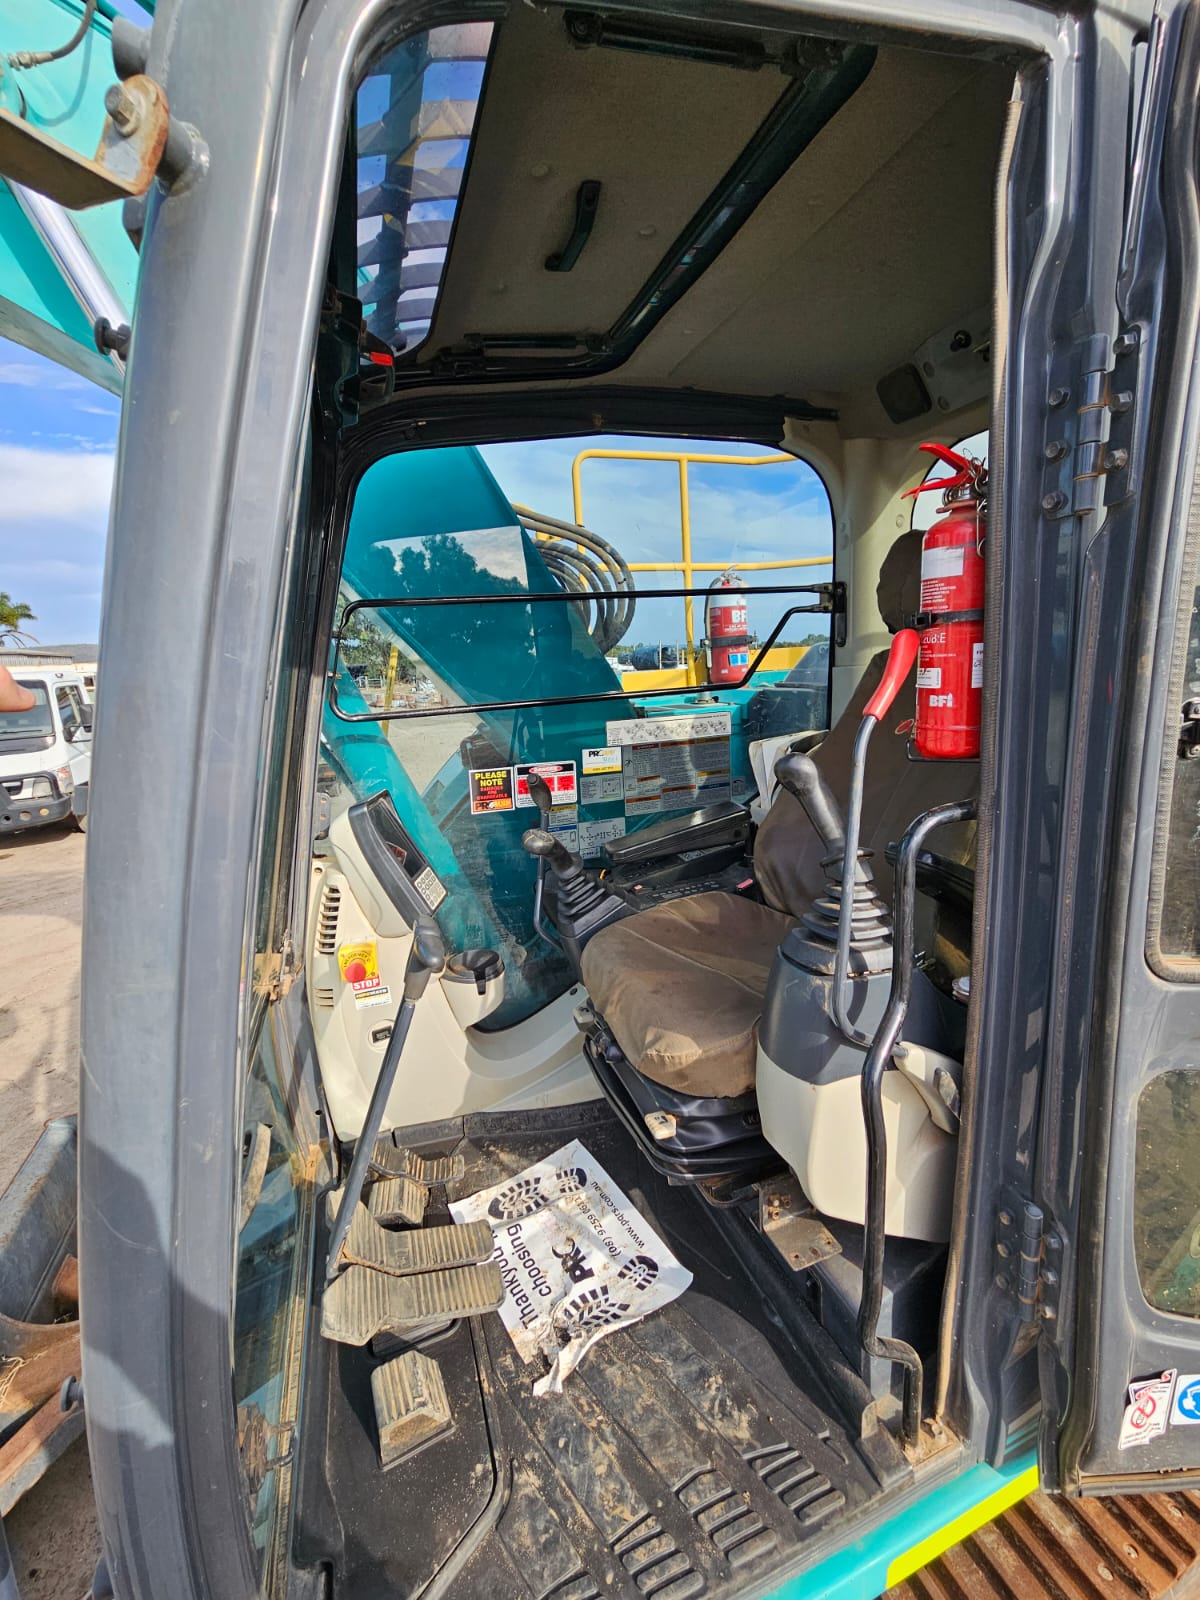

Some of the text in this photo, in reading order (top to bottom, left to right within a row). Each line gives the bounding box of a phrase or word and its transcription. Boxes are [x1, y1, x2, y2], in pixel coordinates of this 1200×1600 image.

[475, 771, 506, 780] PLEASE
[480, 778, 503, 787] NOTE
[353, 979, 379, 990] STOP
[591, 1181, 645, 1249] www.pqrs.com.au
[602, 1236, 622, 1258] (08)
[507, 1223, 552, 1297] choosing
